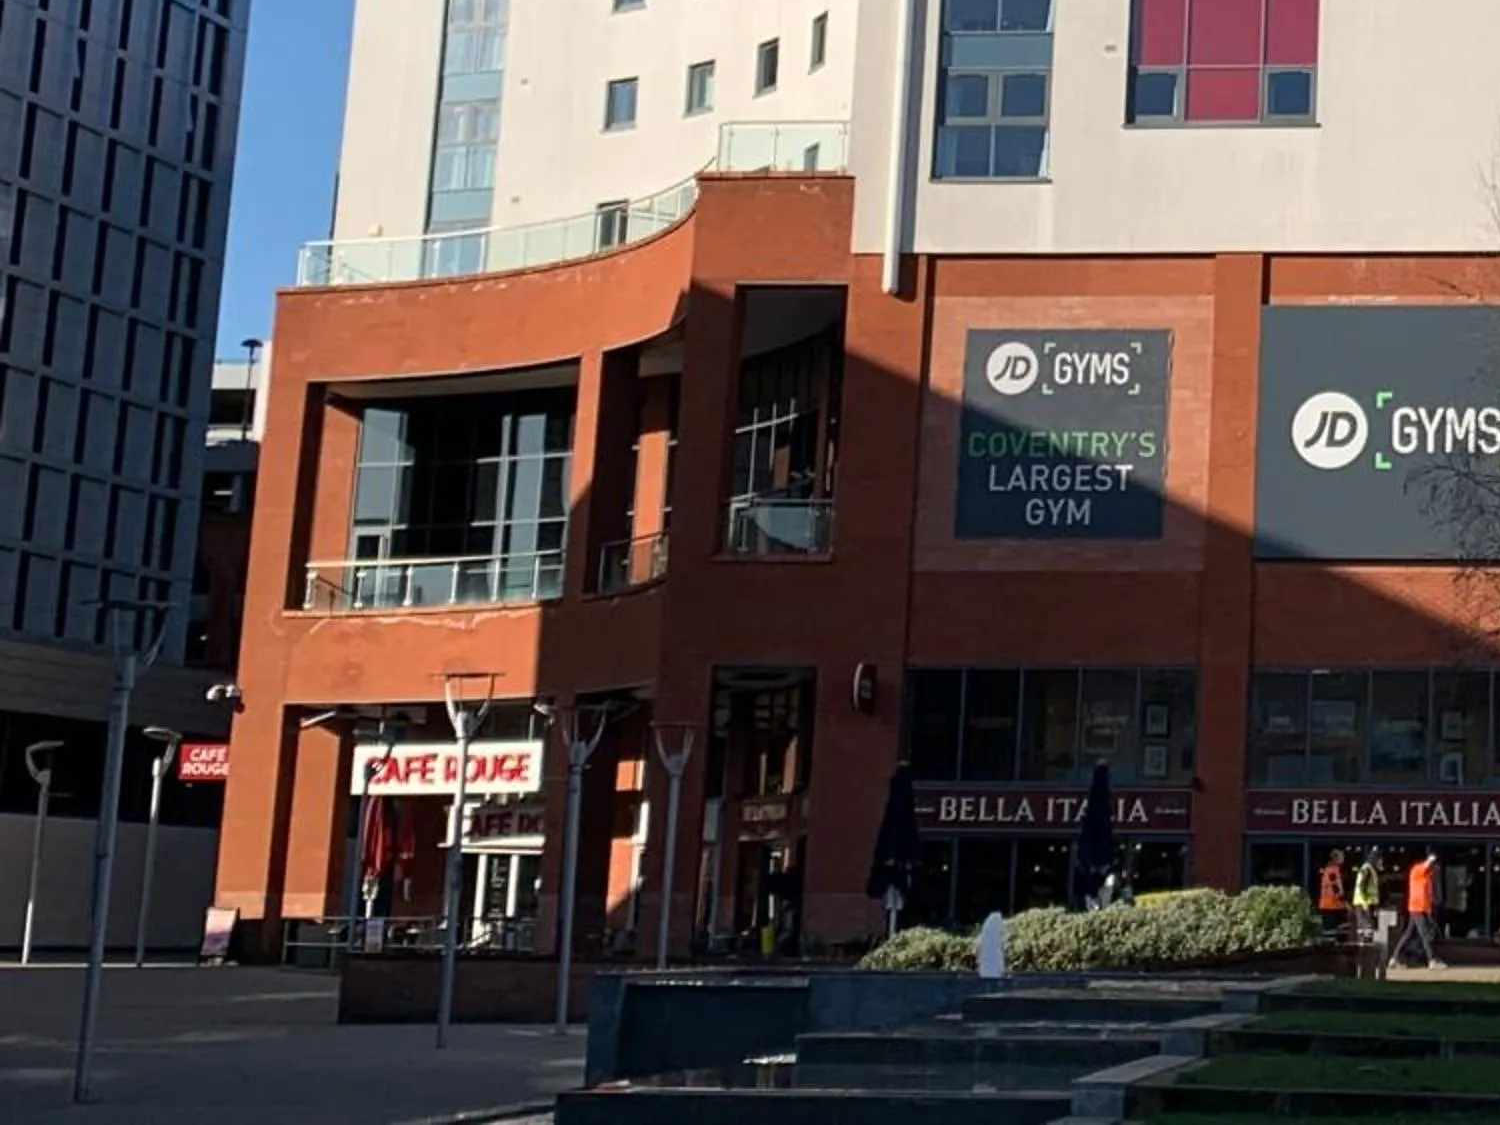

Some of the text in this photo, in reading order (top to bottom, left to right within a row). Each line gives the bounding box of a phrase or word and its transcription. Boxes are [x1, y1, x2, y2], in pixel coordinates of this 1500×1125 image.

[994, 351, 1130, 385] JD GYMS
[1303, 410, 1358, 448] JD
[967, 431, 1156, 458] COVENTRY'S
[988, 464, 1135, 492] LARGEST
[1025, 498, 1091, 525] GYM
[939, 796, 1149, 823] BELLA ITIA
[1291, 799, 1388, 825] BELLA
